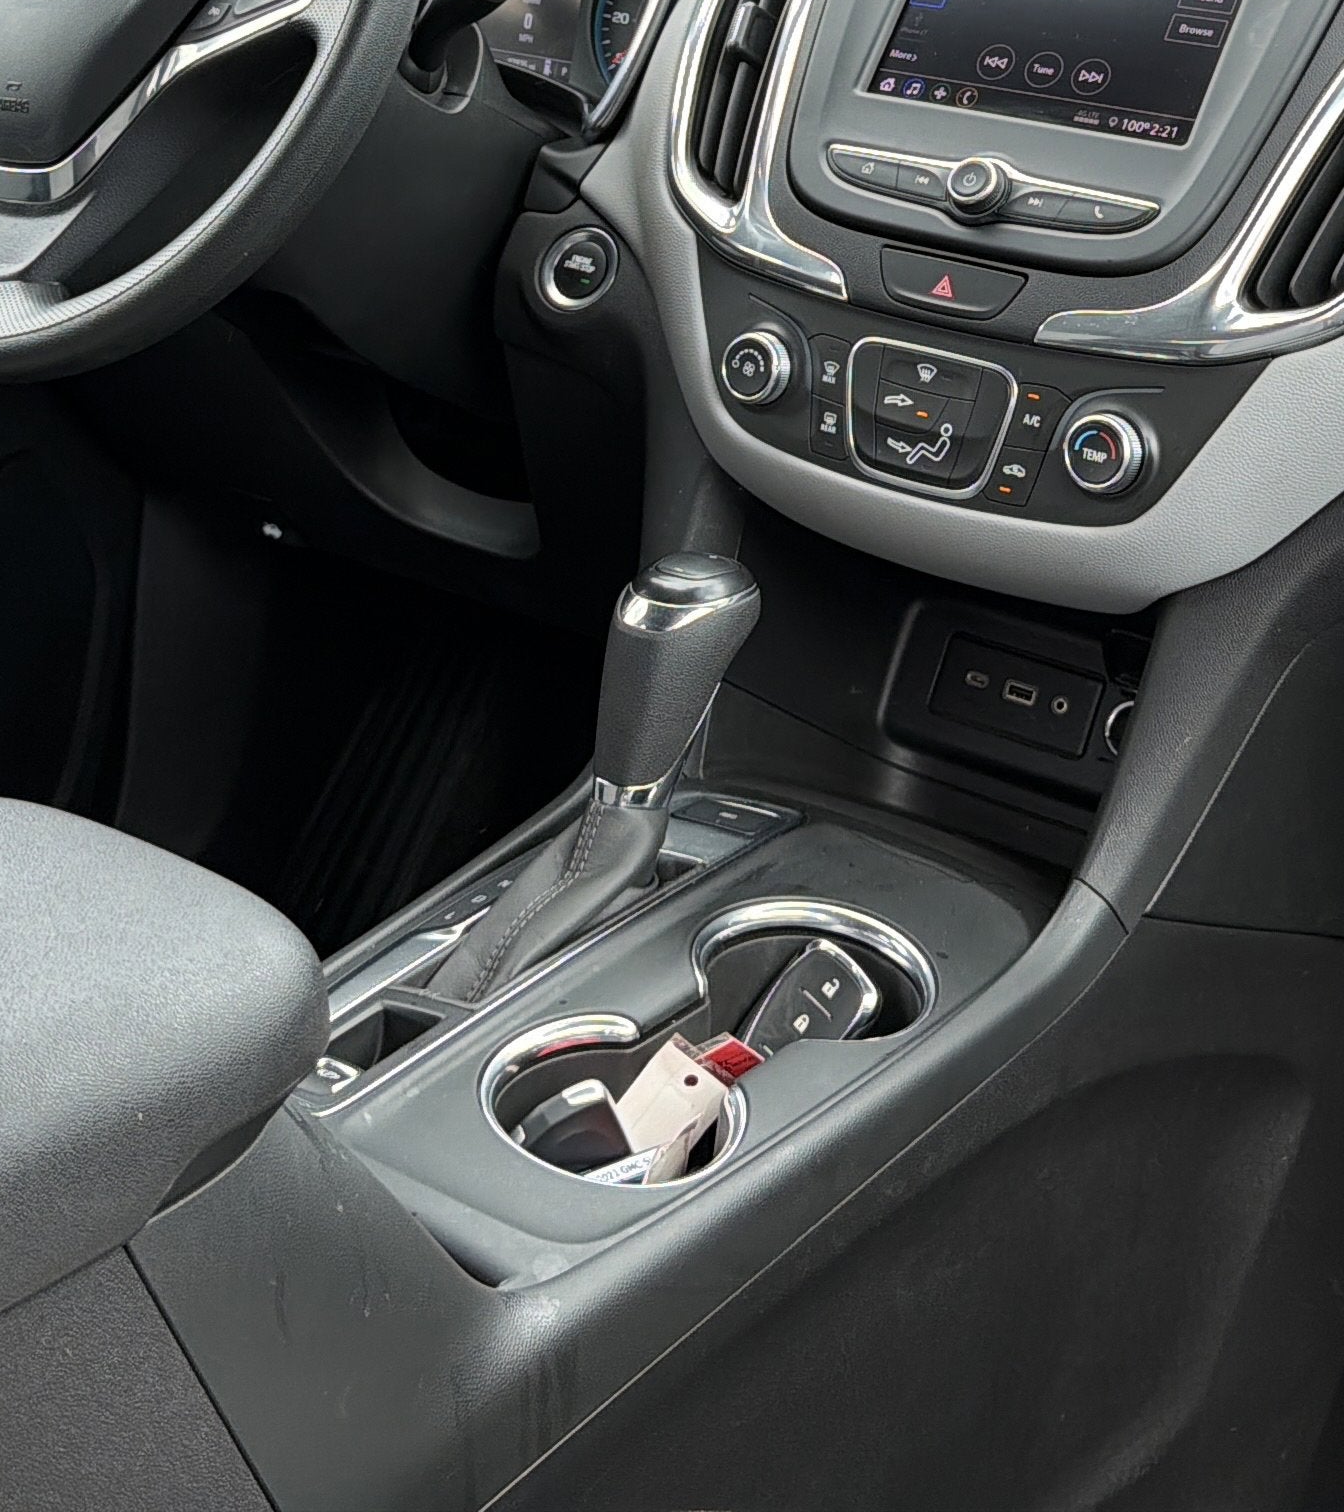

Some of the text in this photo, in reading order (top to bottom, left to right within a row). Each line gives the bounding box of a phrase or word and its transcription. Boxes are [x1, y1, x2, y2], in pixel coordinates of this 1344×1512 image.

[523, 13, 533, 30] 0
[612, 11, 630, 25] 20
[1178, 23, 1214, 37] Browse
[889, 49, 912, 61] More
[1033, 63, 1055, 76] Tune
[1150, 124, 1178, 139] 2:21
[821, 374, 836, 385] MAX
[1023, 413, 1041, 428] A/C
[820, 423, 836, 435] REAR
[1082, 447, 1108, 464] TEMP
[620, 1160, 643, 1174] GMC
